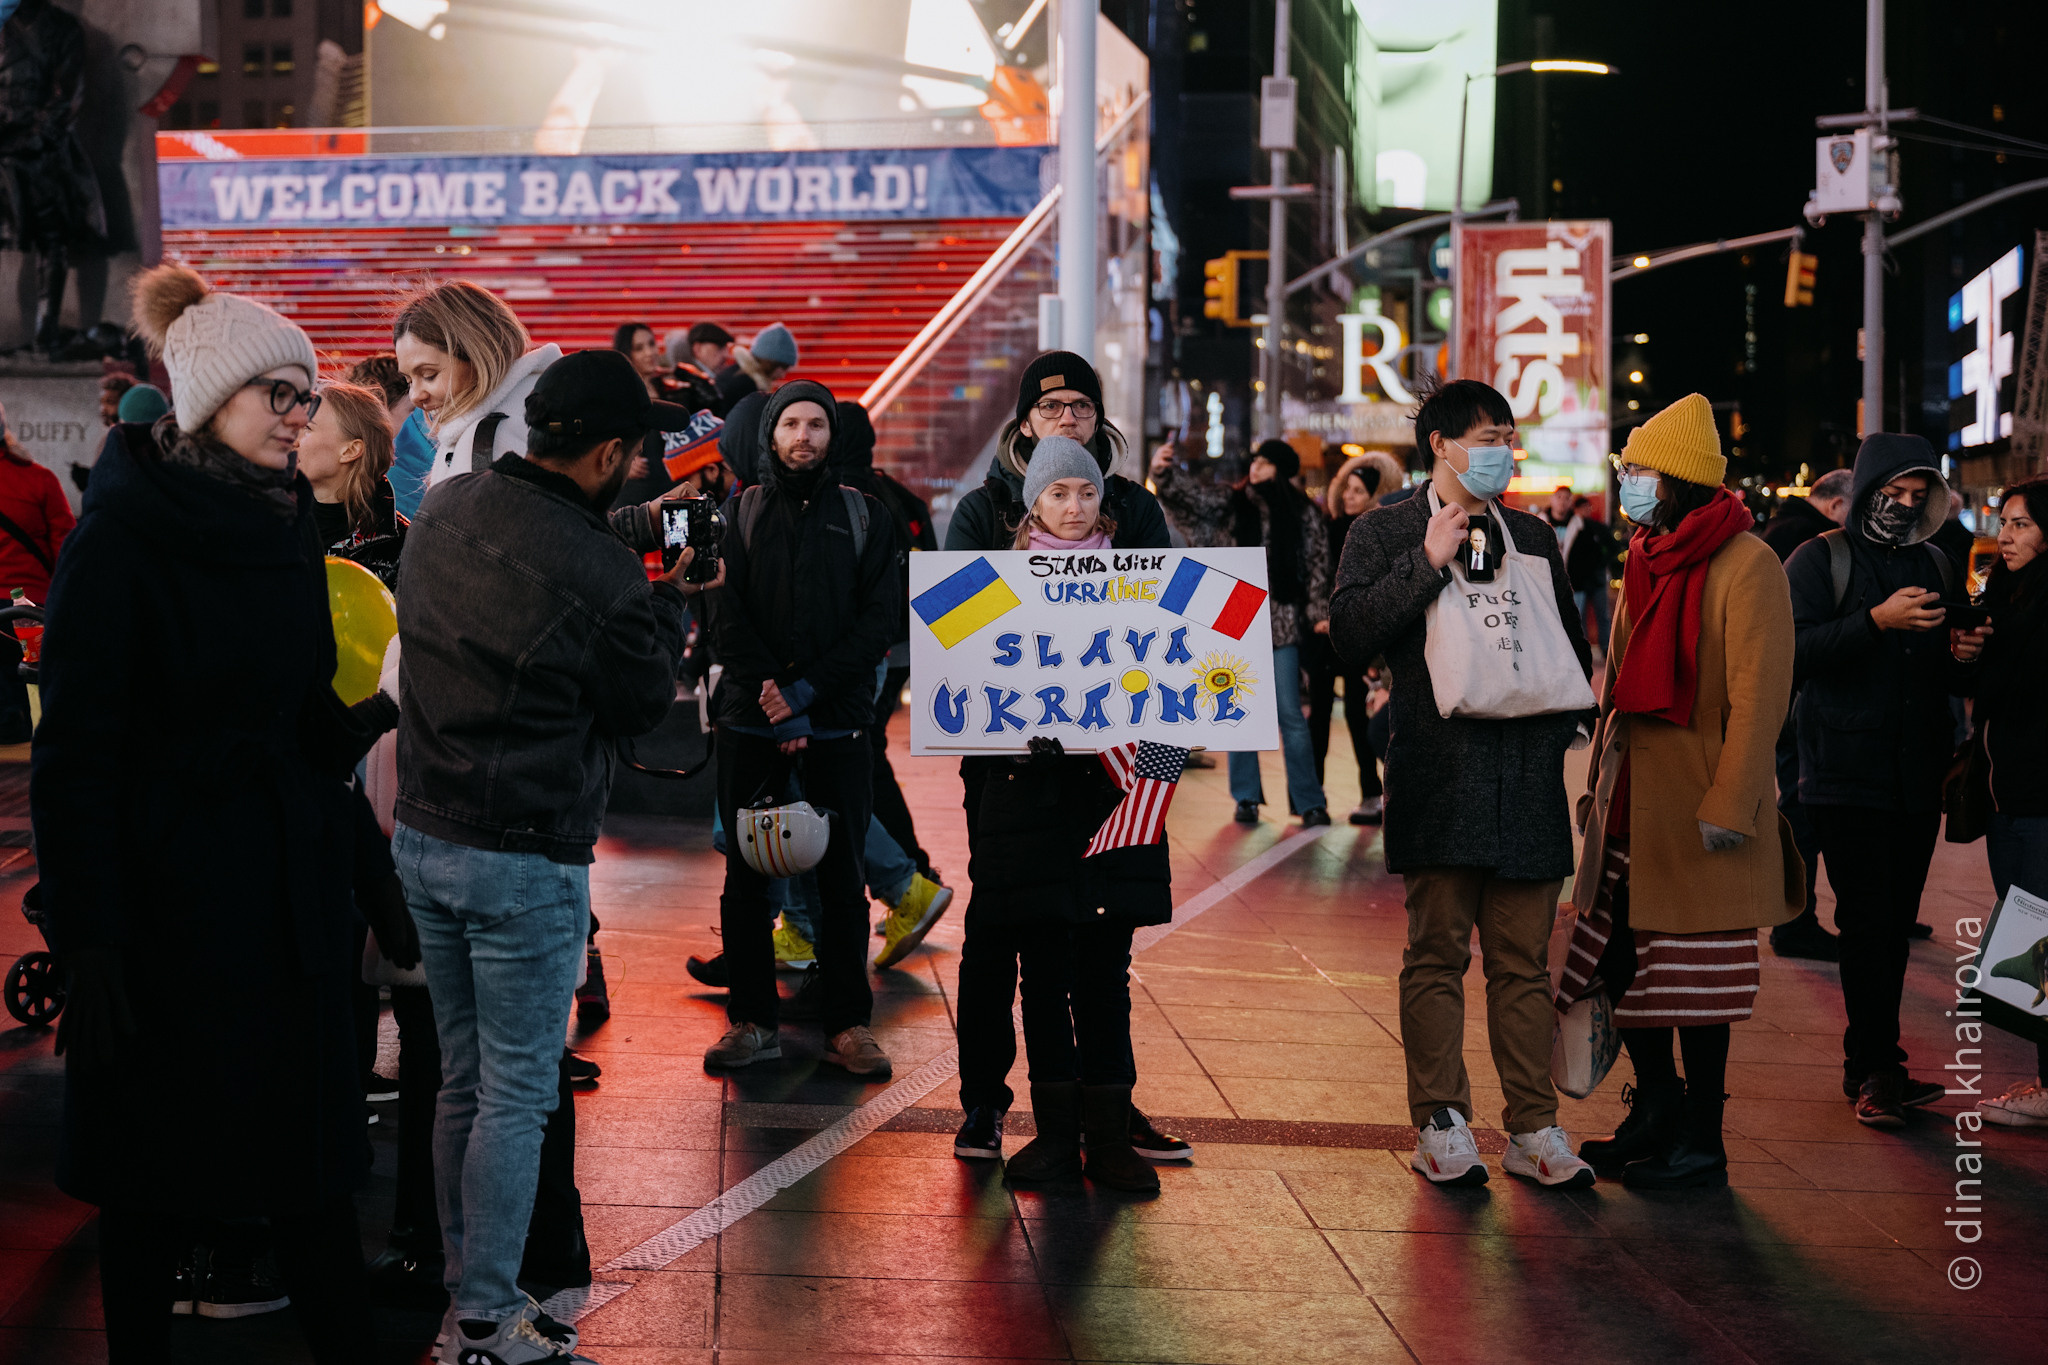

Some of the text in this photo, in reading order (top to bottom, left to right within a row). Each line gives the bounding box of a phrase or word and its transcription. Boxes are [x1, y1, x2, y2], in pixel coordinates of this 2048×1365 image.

[210, 164, 929, 221] WELCOME BACK WORLD!
[1494, 240, 1585, 420] tkts
[1335, 312, 1418, 406] R
[18, 420, 91, 442] DUFFY
[991, 623, 1195, 669] SLAVA
